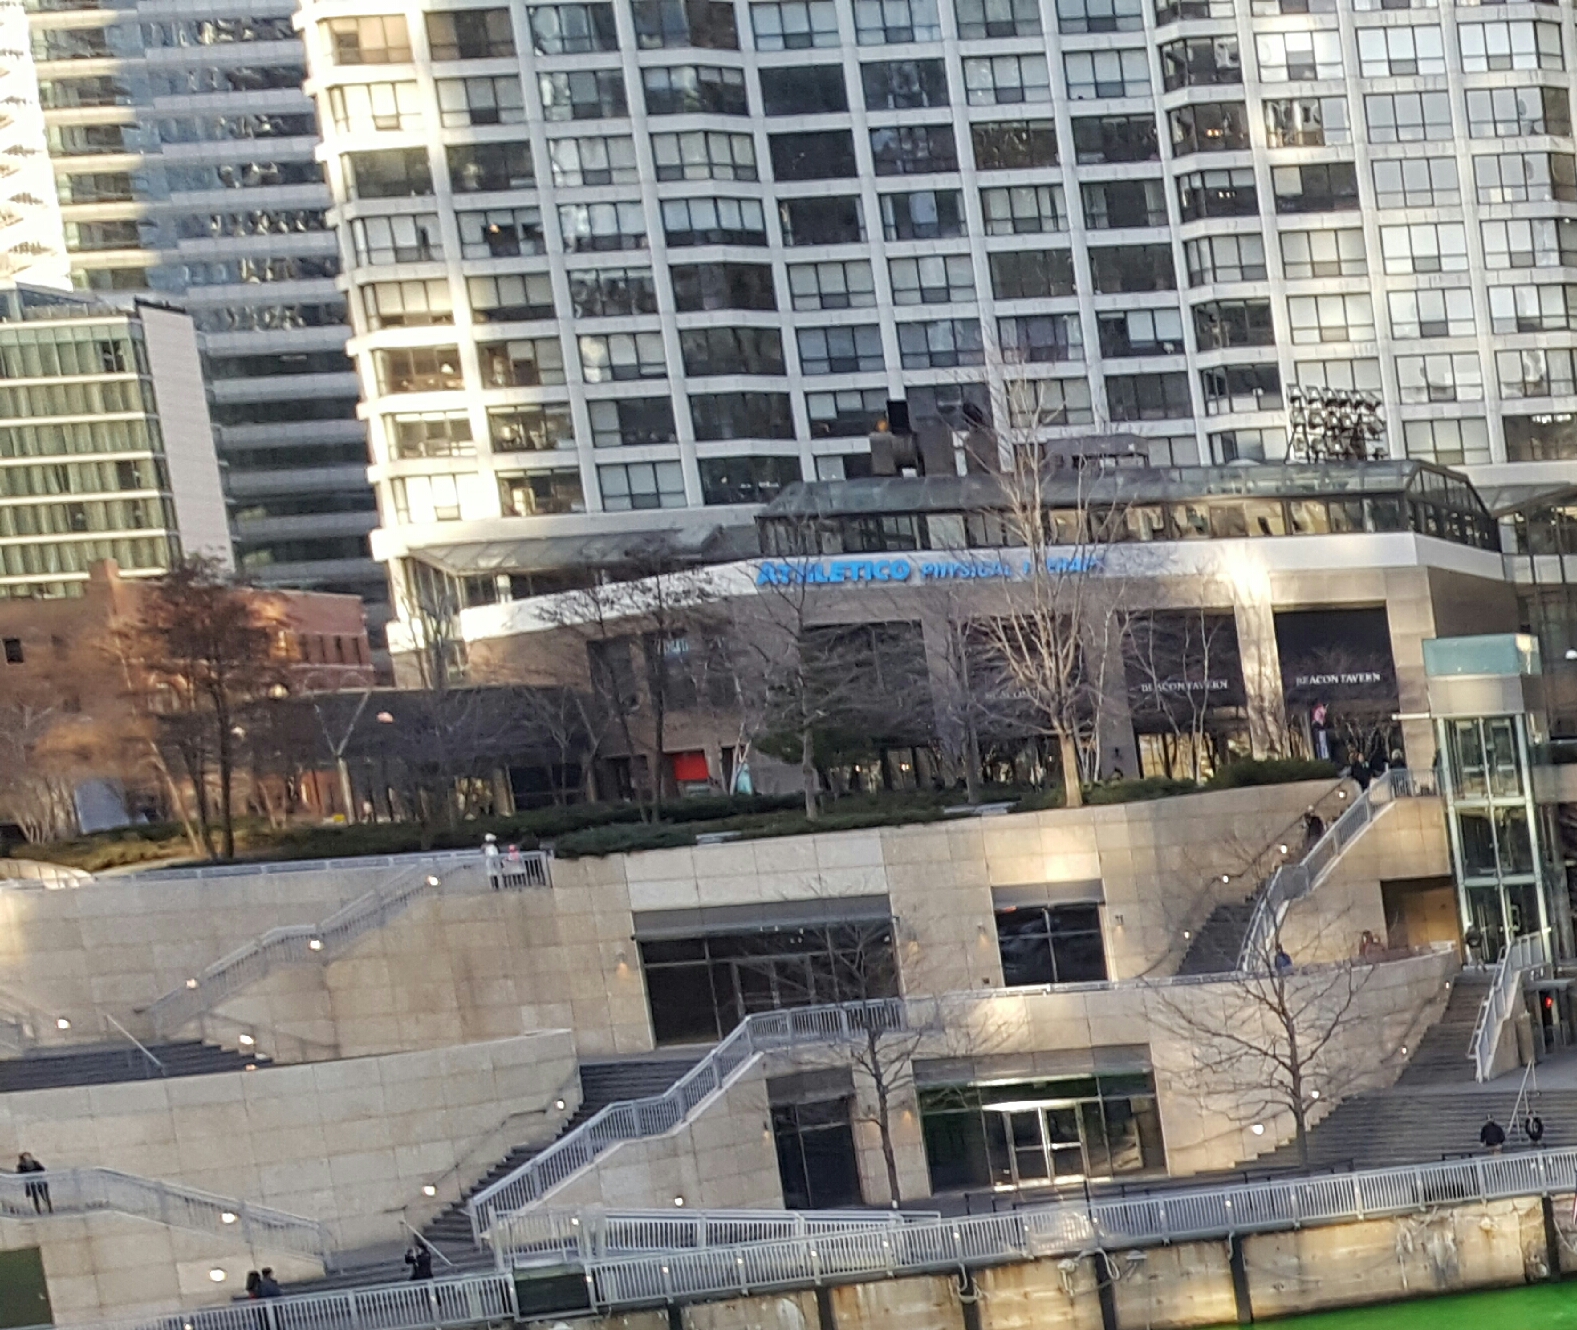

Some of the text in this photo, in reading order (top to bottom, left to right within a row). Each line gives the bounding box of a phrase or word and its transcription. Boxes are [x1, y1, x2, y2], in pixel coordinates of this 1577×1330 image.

[756, 558, 911, 585] ATHLETICO
[1296, 671, 1381, 686] BEACON TAVERN
